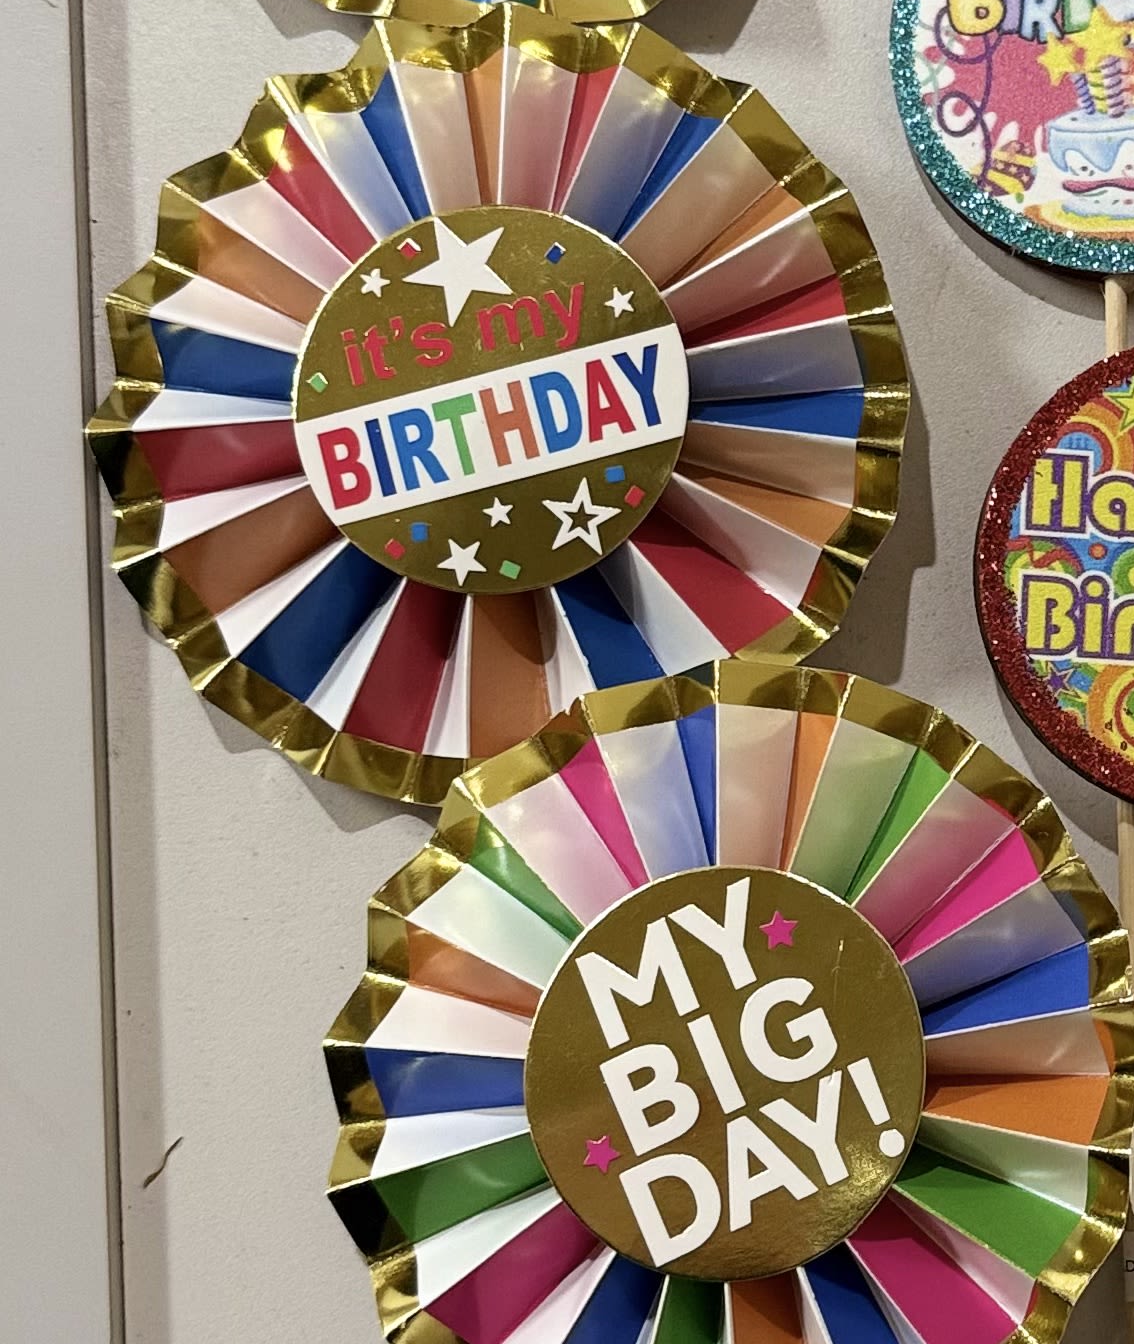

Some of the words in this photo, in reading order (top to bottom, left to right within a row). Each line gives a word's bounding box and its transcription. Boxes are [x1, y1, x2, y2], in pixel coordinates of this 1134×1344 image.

[341, 317, 453, 387] it's
[477, 281, 586, 352] my
[317, 344, 663, 510] BIRTHDAY
[575, 877, 752, 1049] MY
[600, 977, 838, 1157] BIG
[620, 1056, 905, 1267] DAY!
